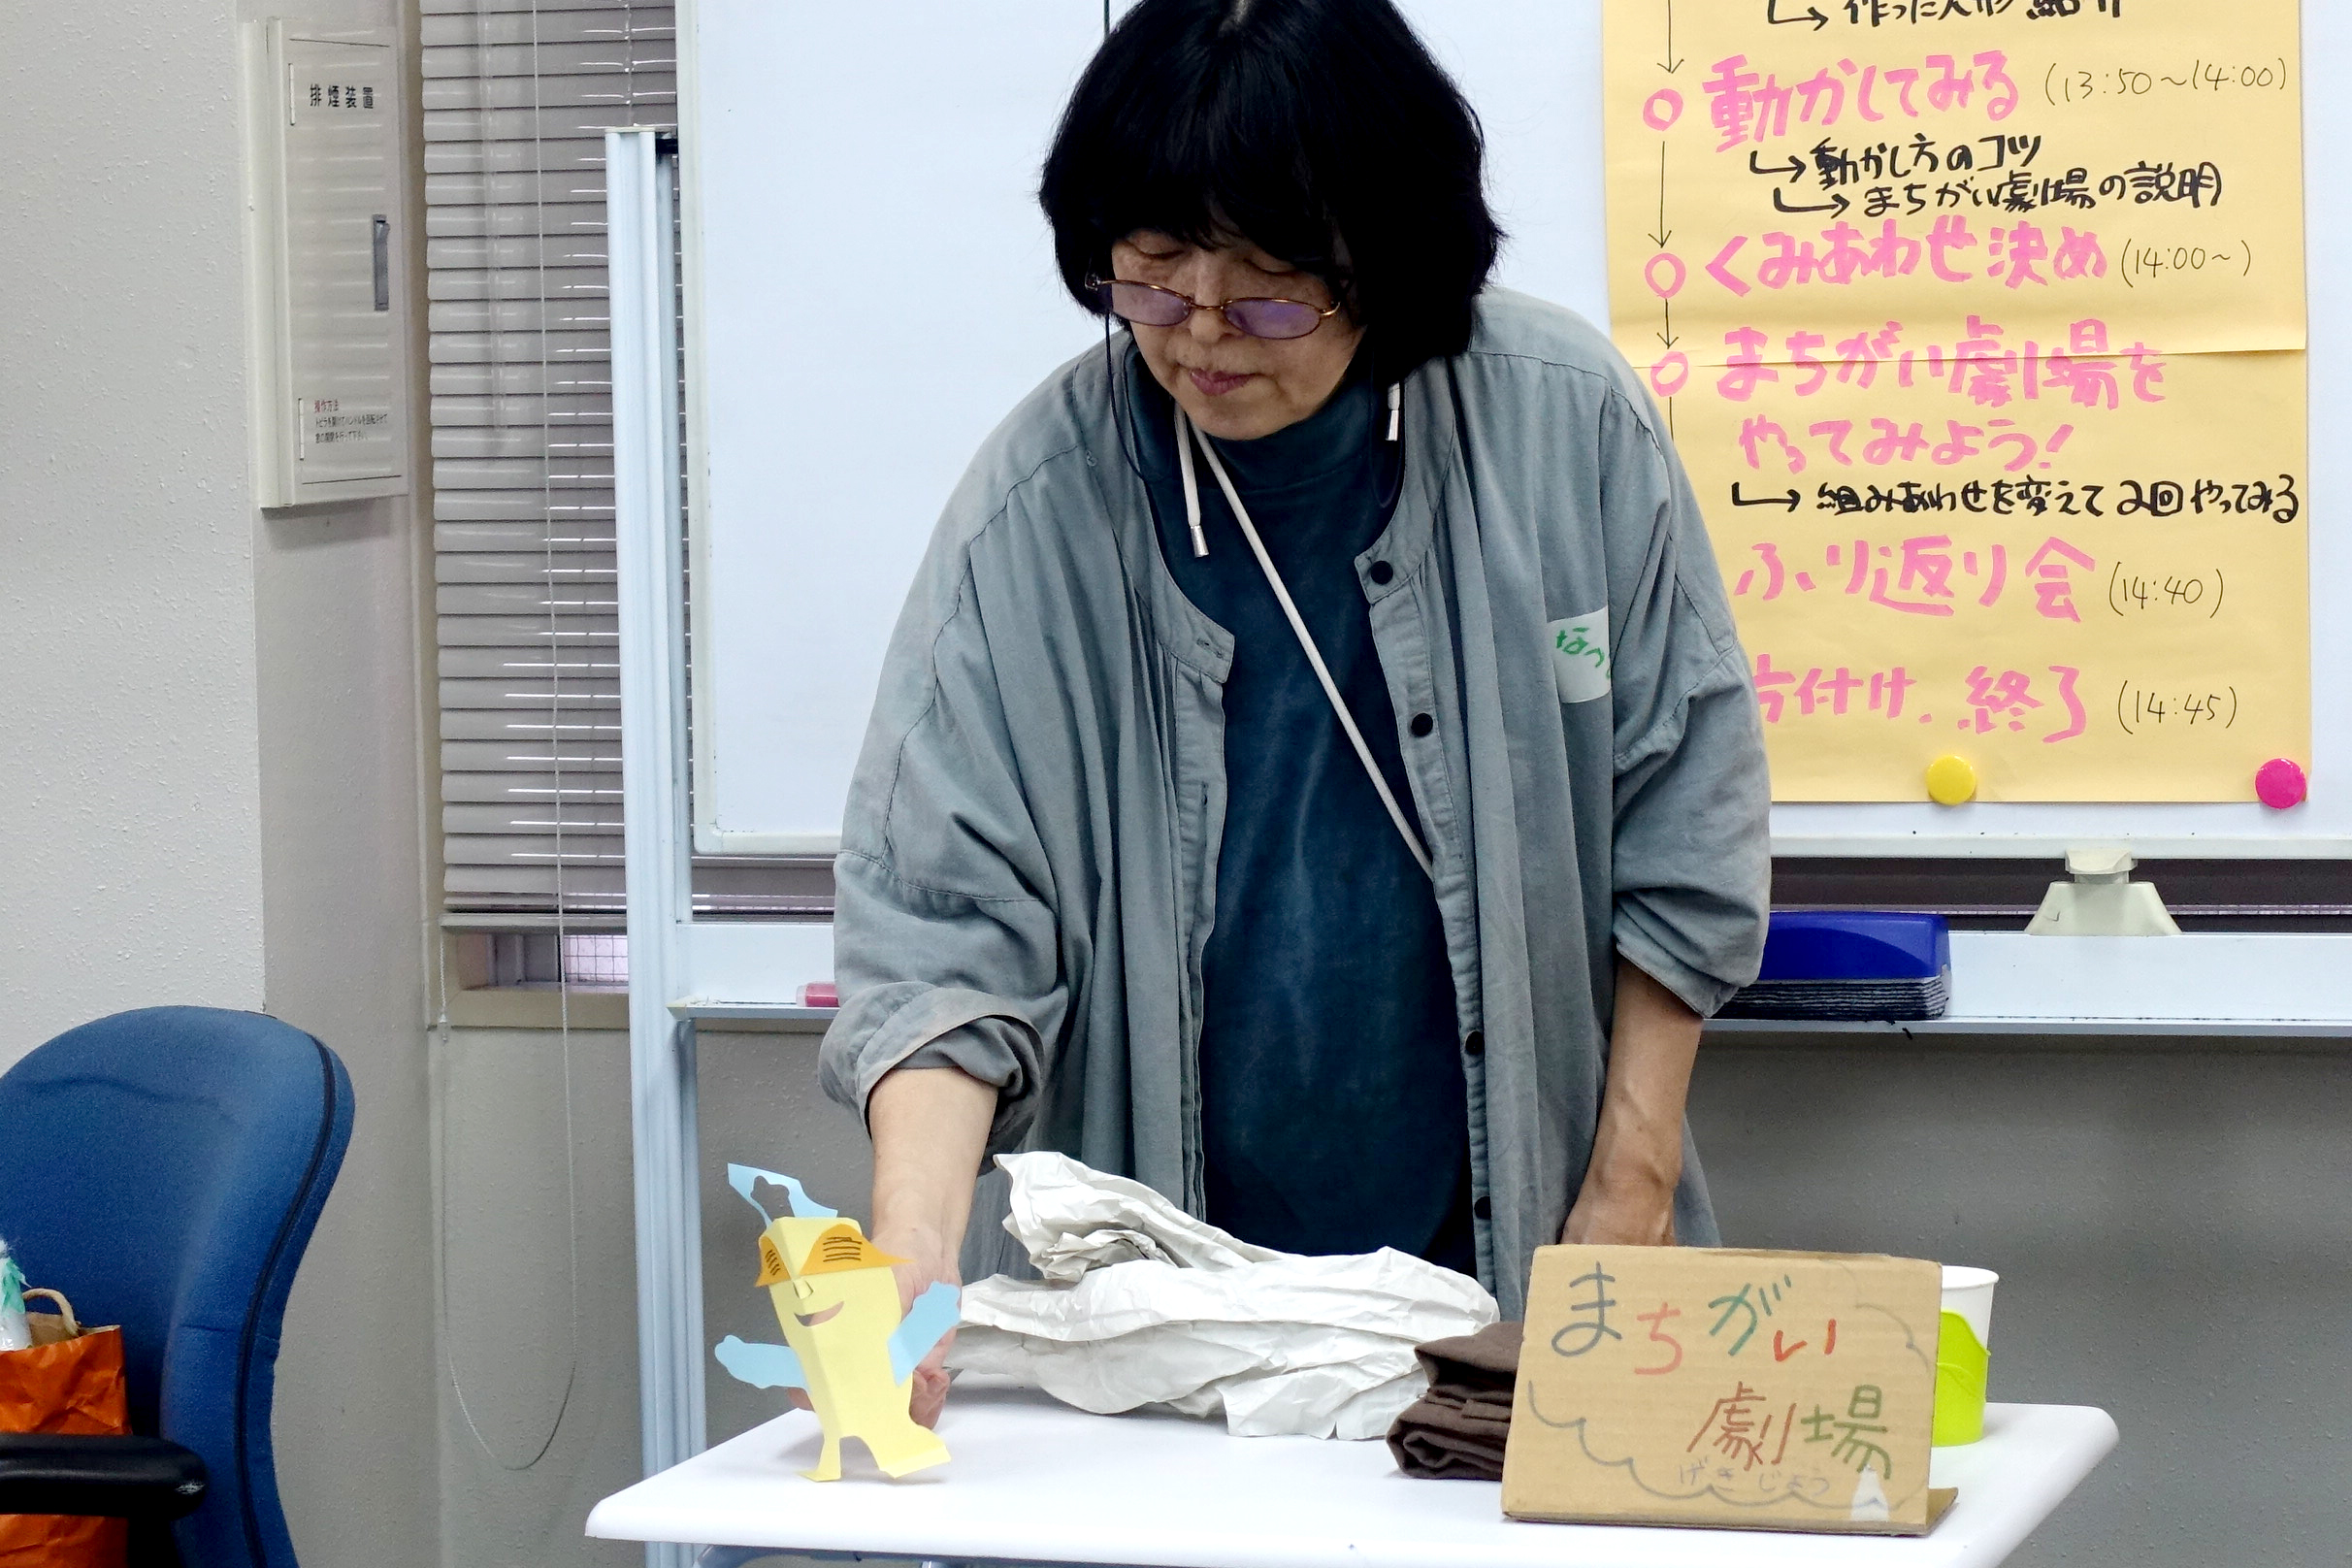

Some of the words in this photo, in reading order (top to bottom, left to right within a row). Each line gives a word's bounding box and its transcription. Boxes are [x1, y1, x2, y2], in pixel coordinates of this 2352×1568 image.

[310, 83, 374, 109] 排煙装置
[1702, 50, 2018, 152] 動かしてみる
[1810, 132, 2042, 190] 動かし方のコツ
[1864, 161, 2222, 215] まちがい劇場の説明
[1705, 214, 2107, 298] くみあわせ決め
[1716, 314, 2167, 410] まちがい劇場を
[1734, 535, 2096, 623] ふり返り会
[2108, 561, 2224, 618] (14:40)
[2117, 679, 2238, 735] (14:45)
[1552, 1261, 1837, 1375] まちがい
[1686, 1381, 1891, 1480] 劇場
